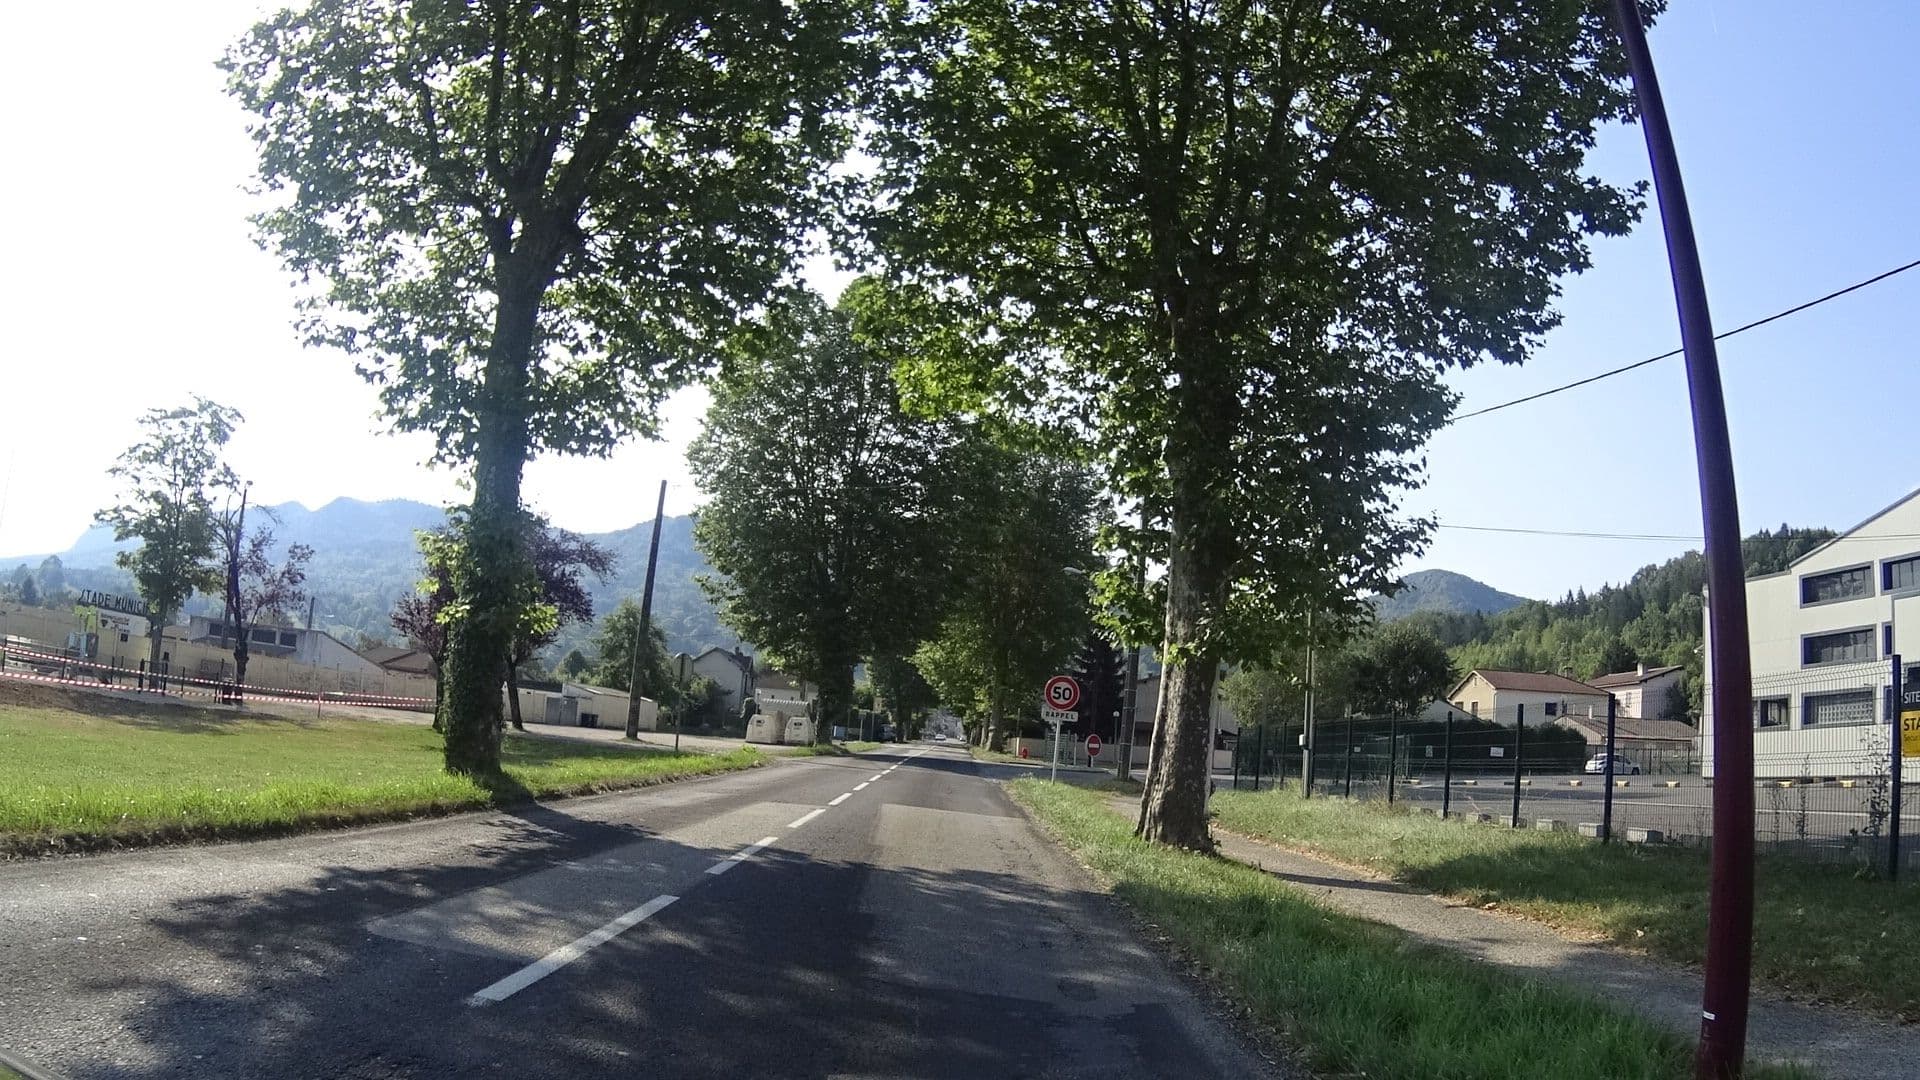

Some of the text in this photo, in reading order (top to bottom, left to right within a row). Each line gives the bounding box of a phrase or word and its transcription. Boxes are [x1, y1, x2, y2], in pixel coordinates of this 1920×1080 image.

[78, 588, 147, 616] STADE MUNICI
[1052, 686, 1073, 701] 50
[1045, 710, 1075, 720] RAPPEL
